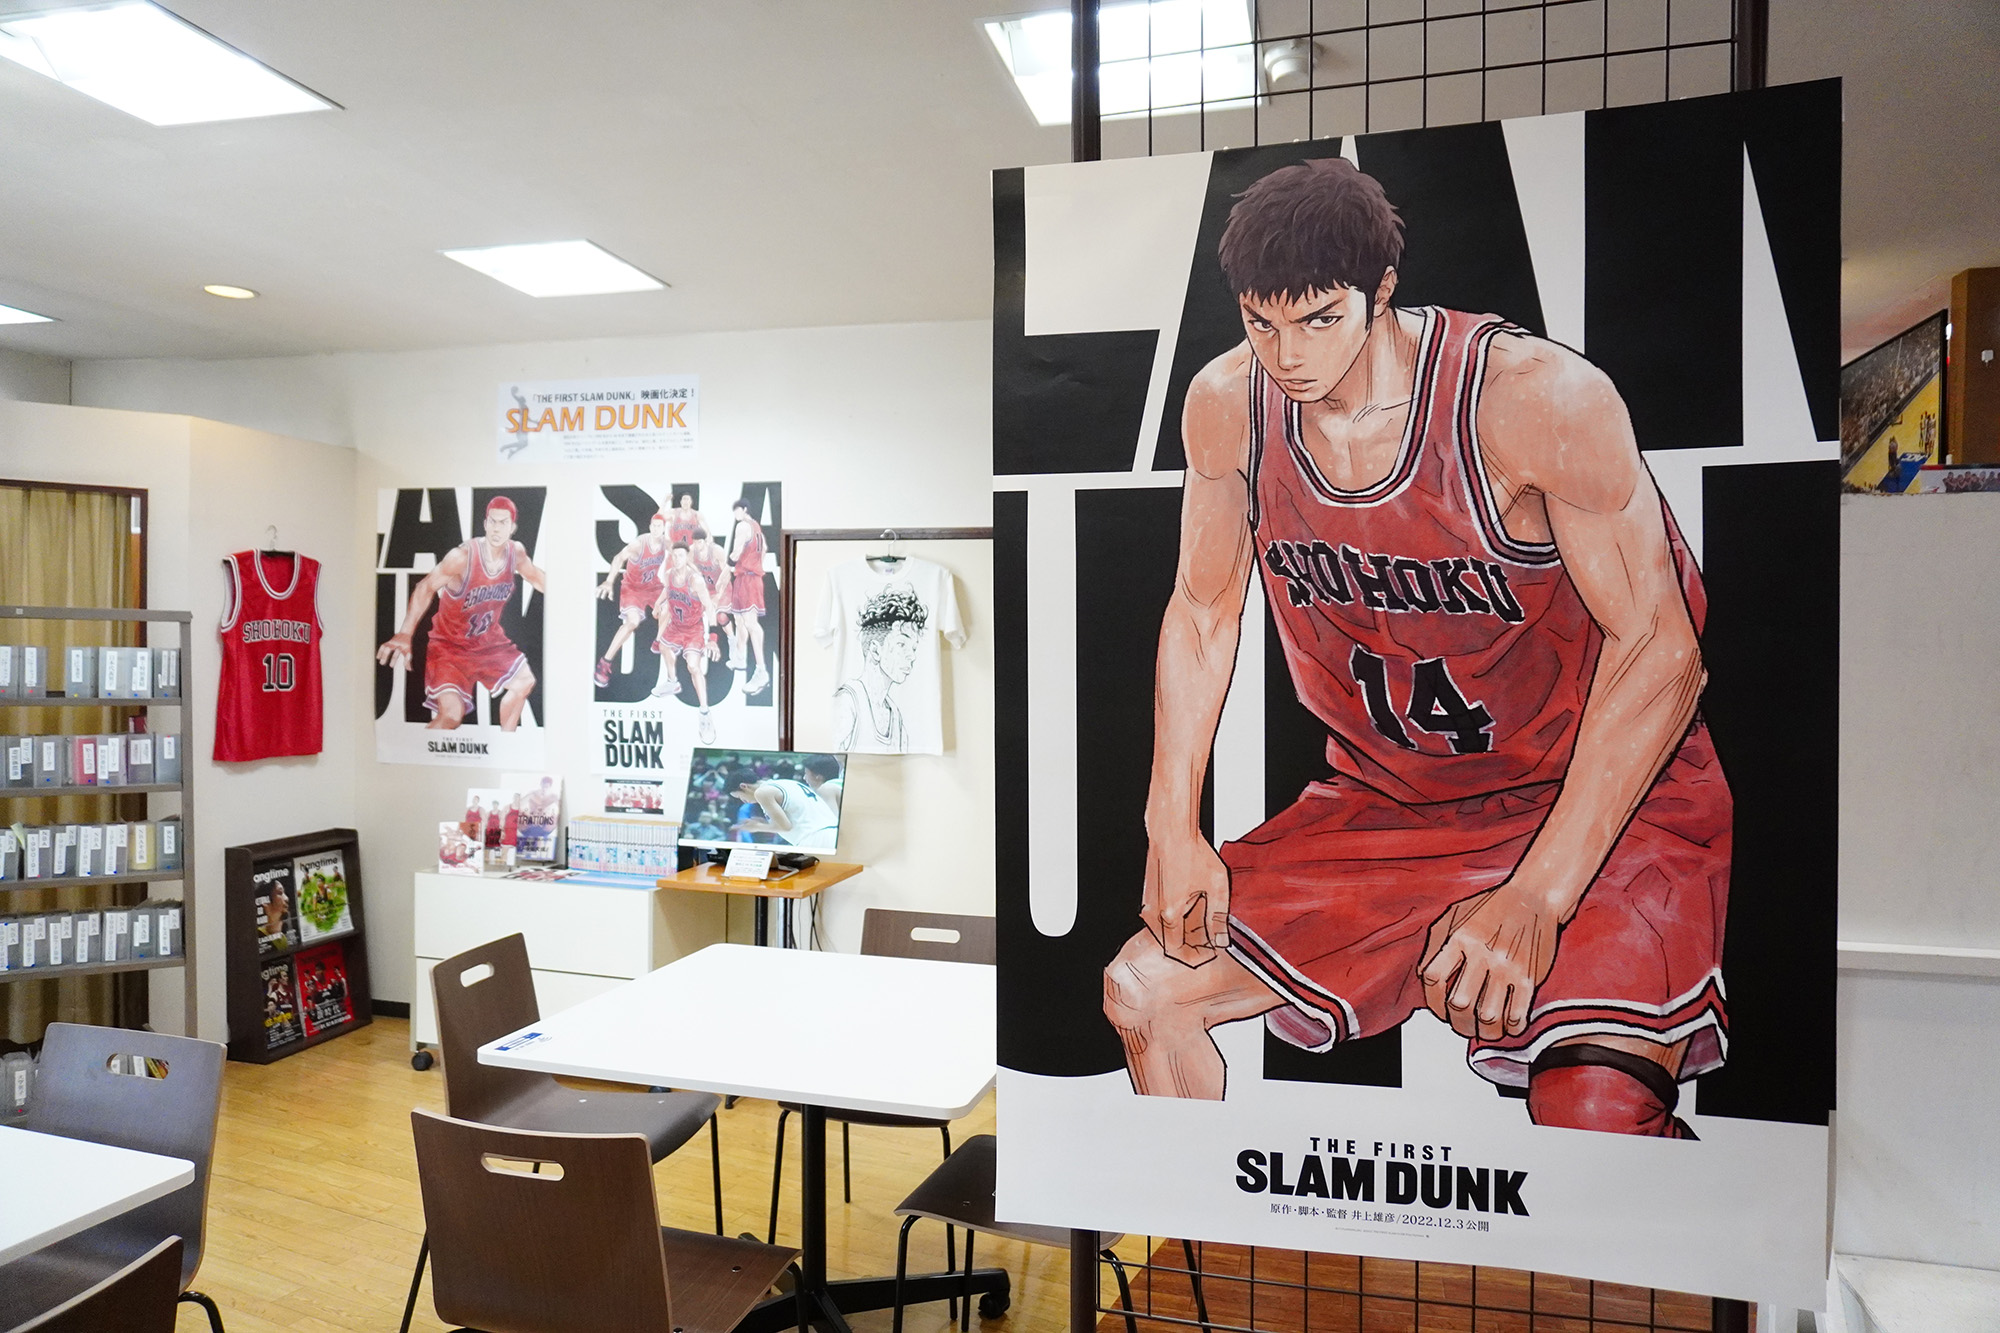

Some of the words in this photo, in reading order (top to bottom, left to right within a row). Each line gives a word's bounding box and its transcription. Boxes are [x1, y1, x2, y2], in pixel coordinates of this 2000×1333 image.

[555, 392, 579, 403] FIRST
[580, 391, 604, 401] SLAM
[506, 406, 585, 433] SLAM
[594, 402, 687, 431] DUNK
[1263, 539, 1526, 625] SHOHOKU
[242, 619, 312, 644] SHOHOKU
[262, 653, 295, 692] 10
[1348, 643, 1497, 755] 14
[603, 709, 622, 718] THE
[630, 710, 663, 719] FIRST
[604, 719, 664, 744] SLAM
[428, 741, 457, 754] SLAM
[459, 742, 489, 755] DUNK
[605, 743, 664, 769] DUNK
[797, 783, 818, 802] 4
[300, 857, 338, 871] hangtime
[1310, 1137, 1356, 1155] THE
[1374, 1141, 1453, 1161] FIRST
[1235, 1148, 1375, 1203] SLAM
[1386, 1160, 1530, 1217] DUNK
